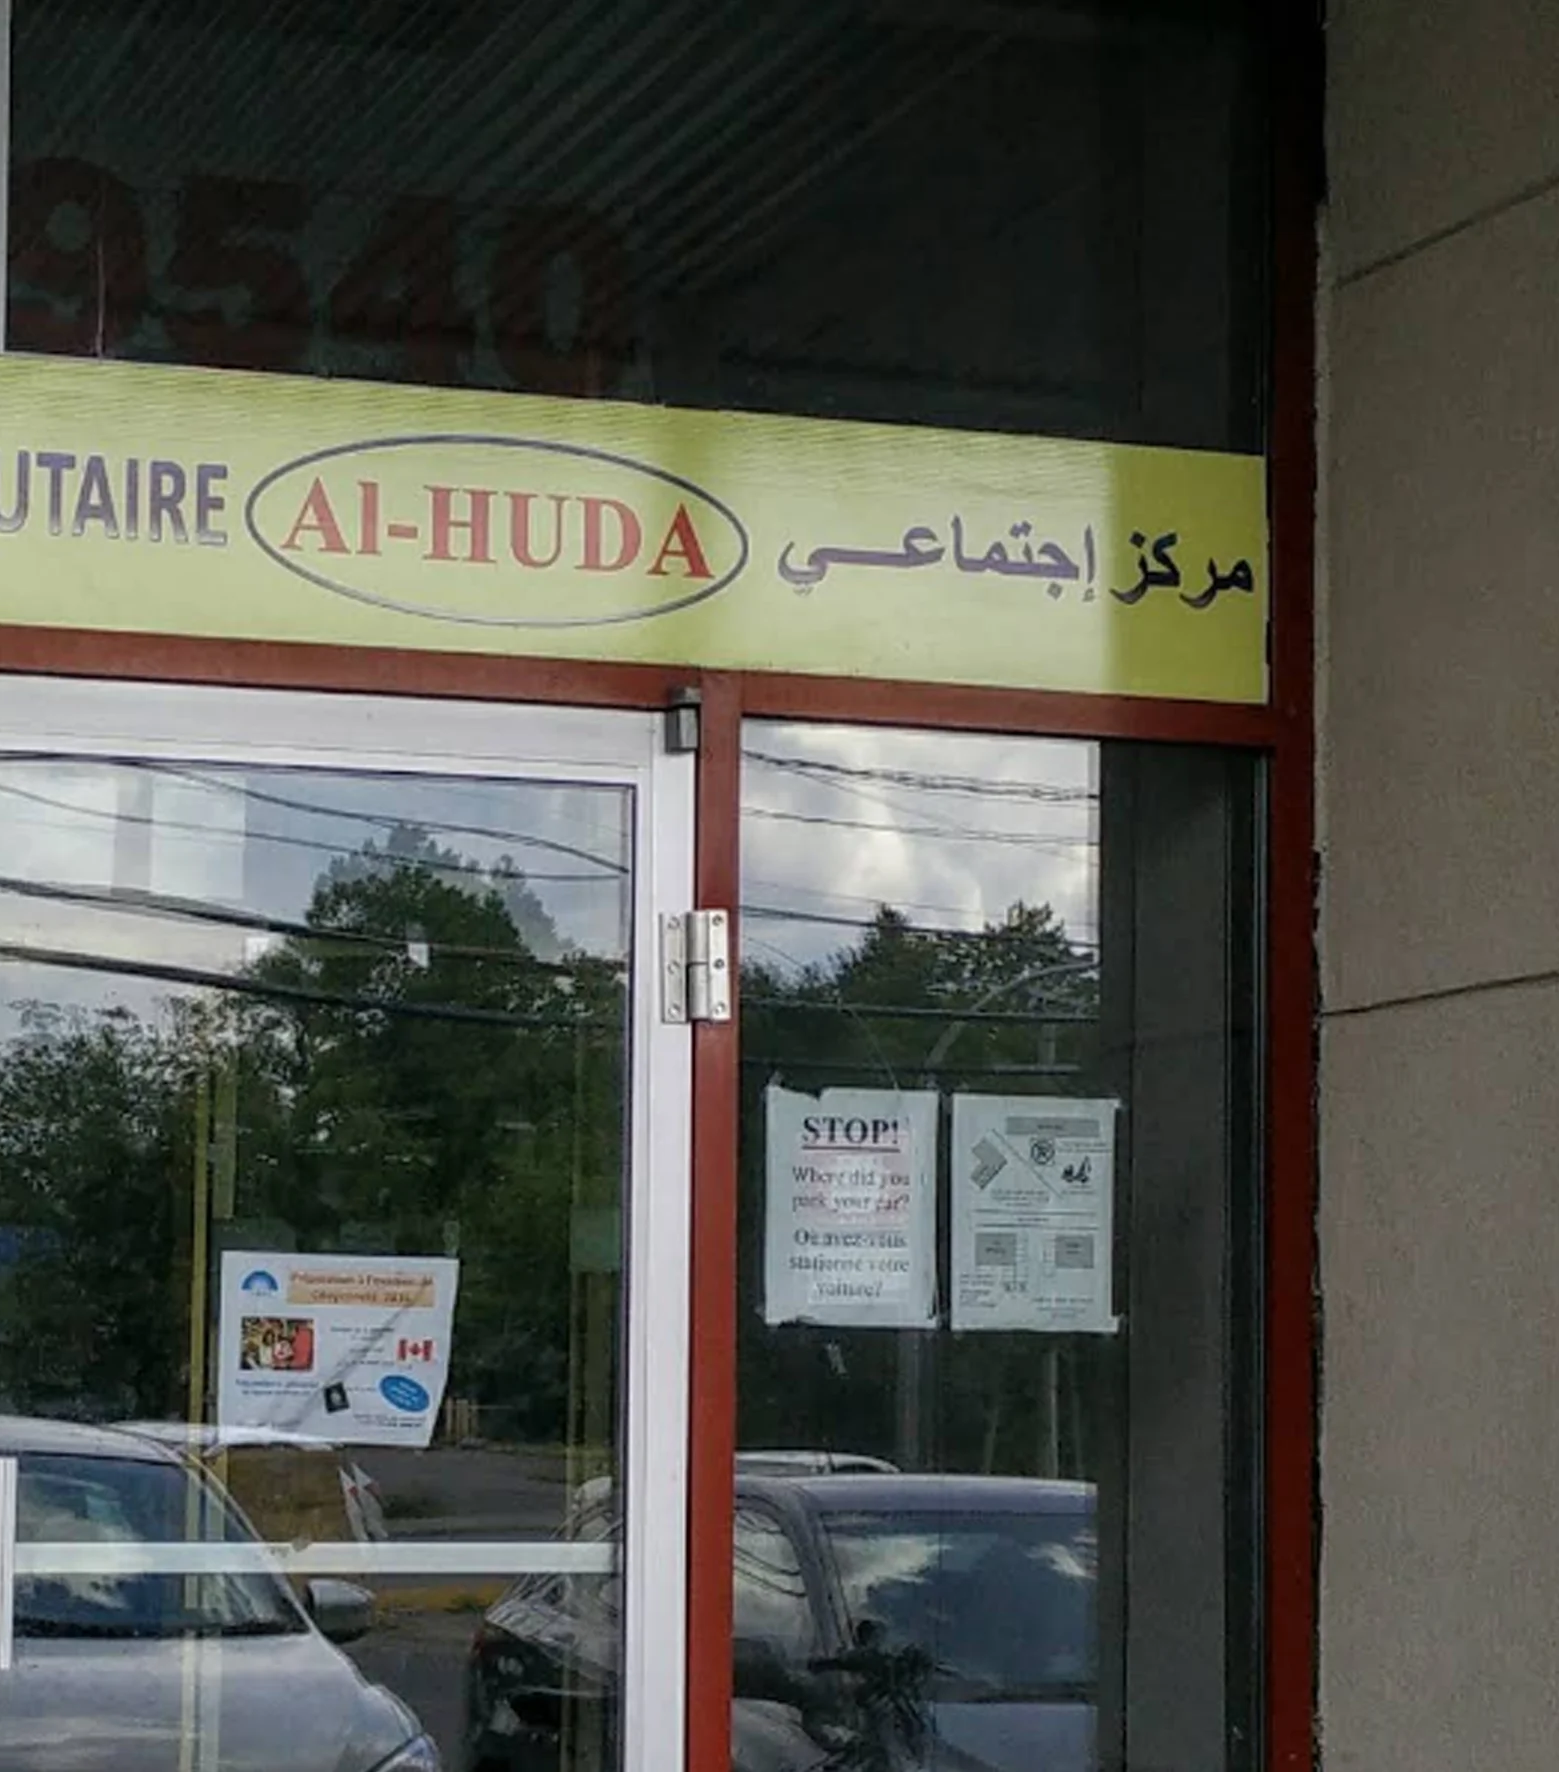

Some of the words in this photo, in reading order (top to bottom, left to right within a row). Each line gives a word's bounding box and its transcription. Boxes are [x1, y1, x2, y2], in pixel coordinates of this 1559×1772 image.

[281, 476, 715, 580] Al-HUDA
[1110, 530, 1254, 610] مركز
[802, 1117, 899, 1144] STOP!
[792, 1167, 845, 1184] Where
[849, 1169, 875, 1186] did
[880, 1174, 910, 1189] you
[834, 1196, 870, 1212] your
